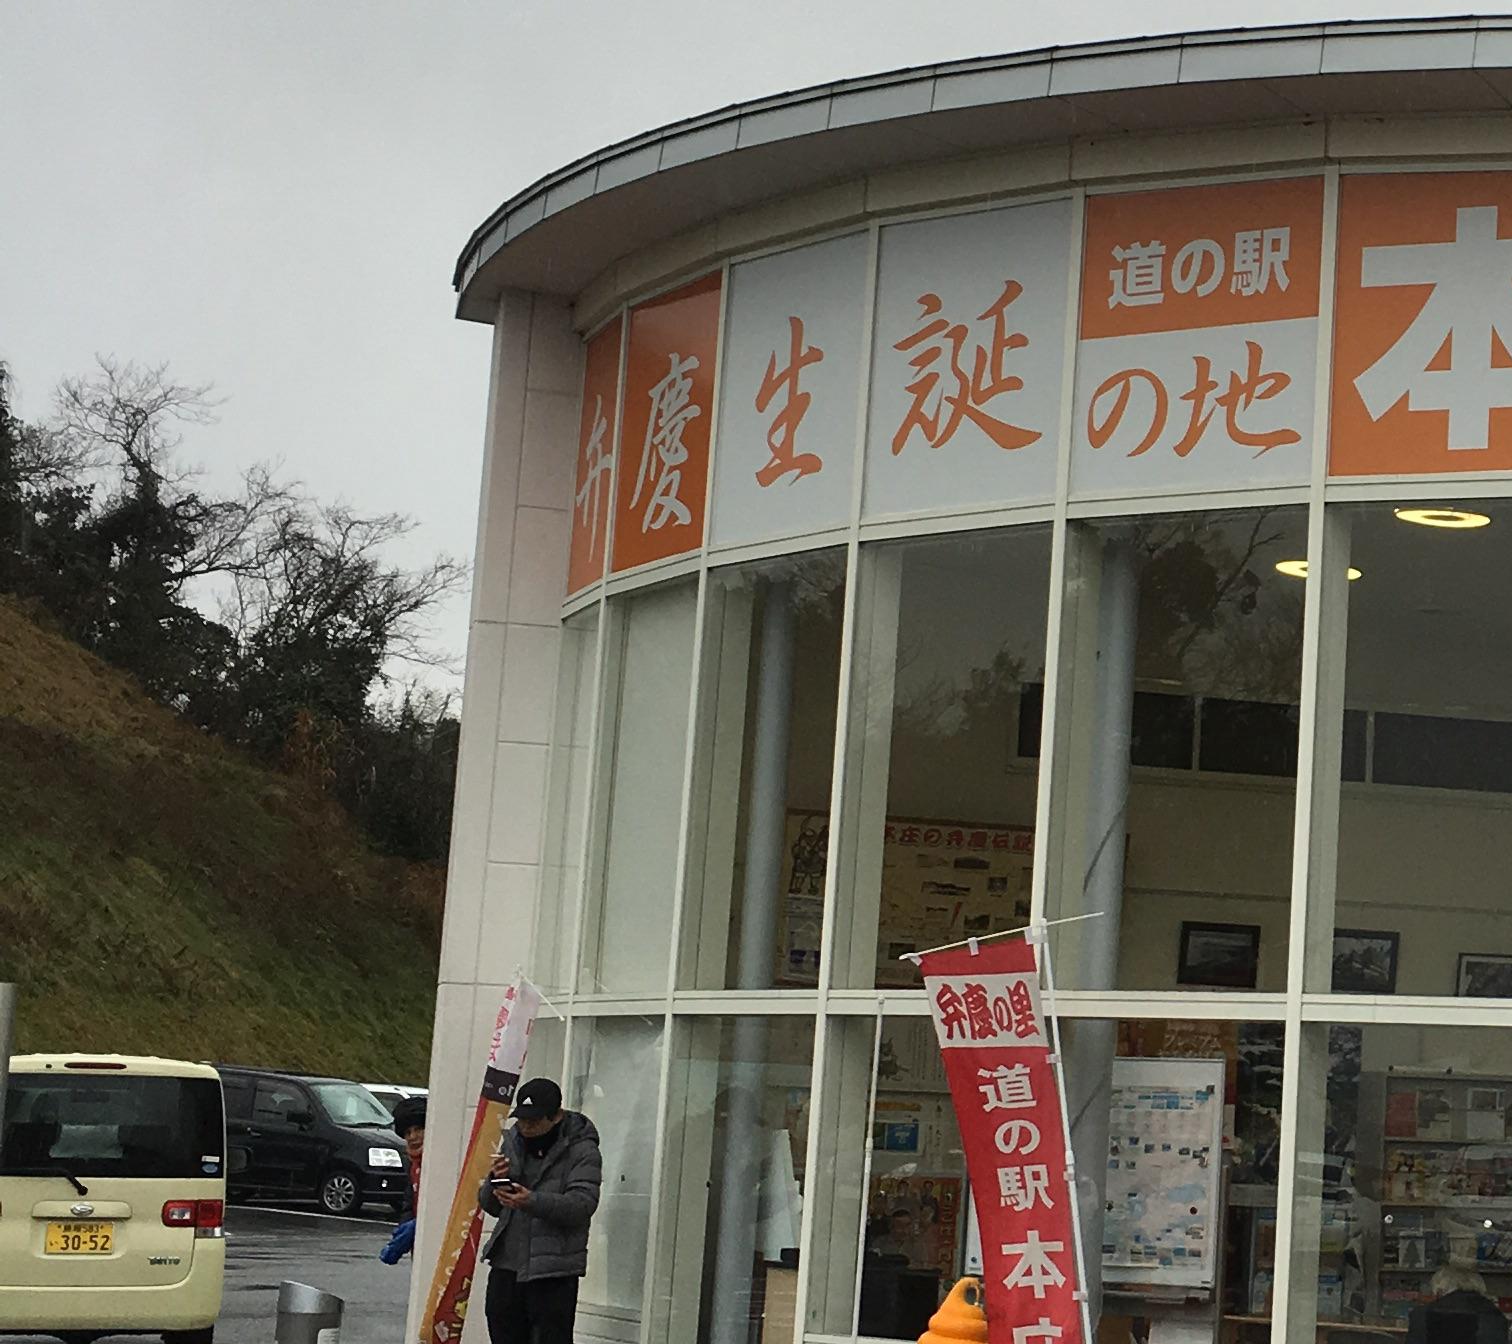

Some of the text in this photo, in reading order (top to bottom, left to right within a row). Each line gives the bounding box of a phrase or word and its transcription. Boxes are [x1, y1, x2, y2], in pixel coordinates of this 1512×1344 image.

[1107, 226, 1291, 311] 道の駅
[936, 980, 1040, 1041] 弁慶の里
[978, 1064, 1055, 1212] 道の駅
[60, 1234, 110, 1251] 30-52
